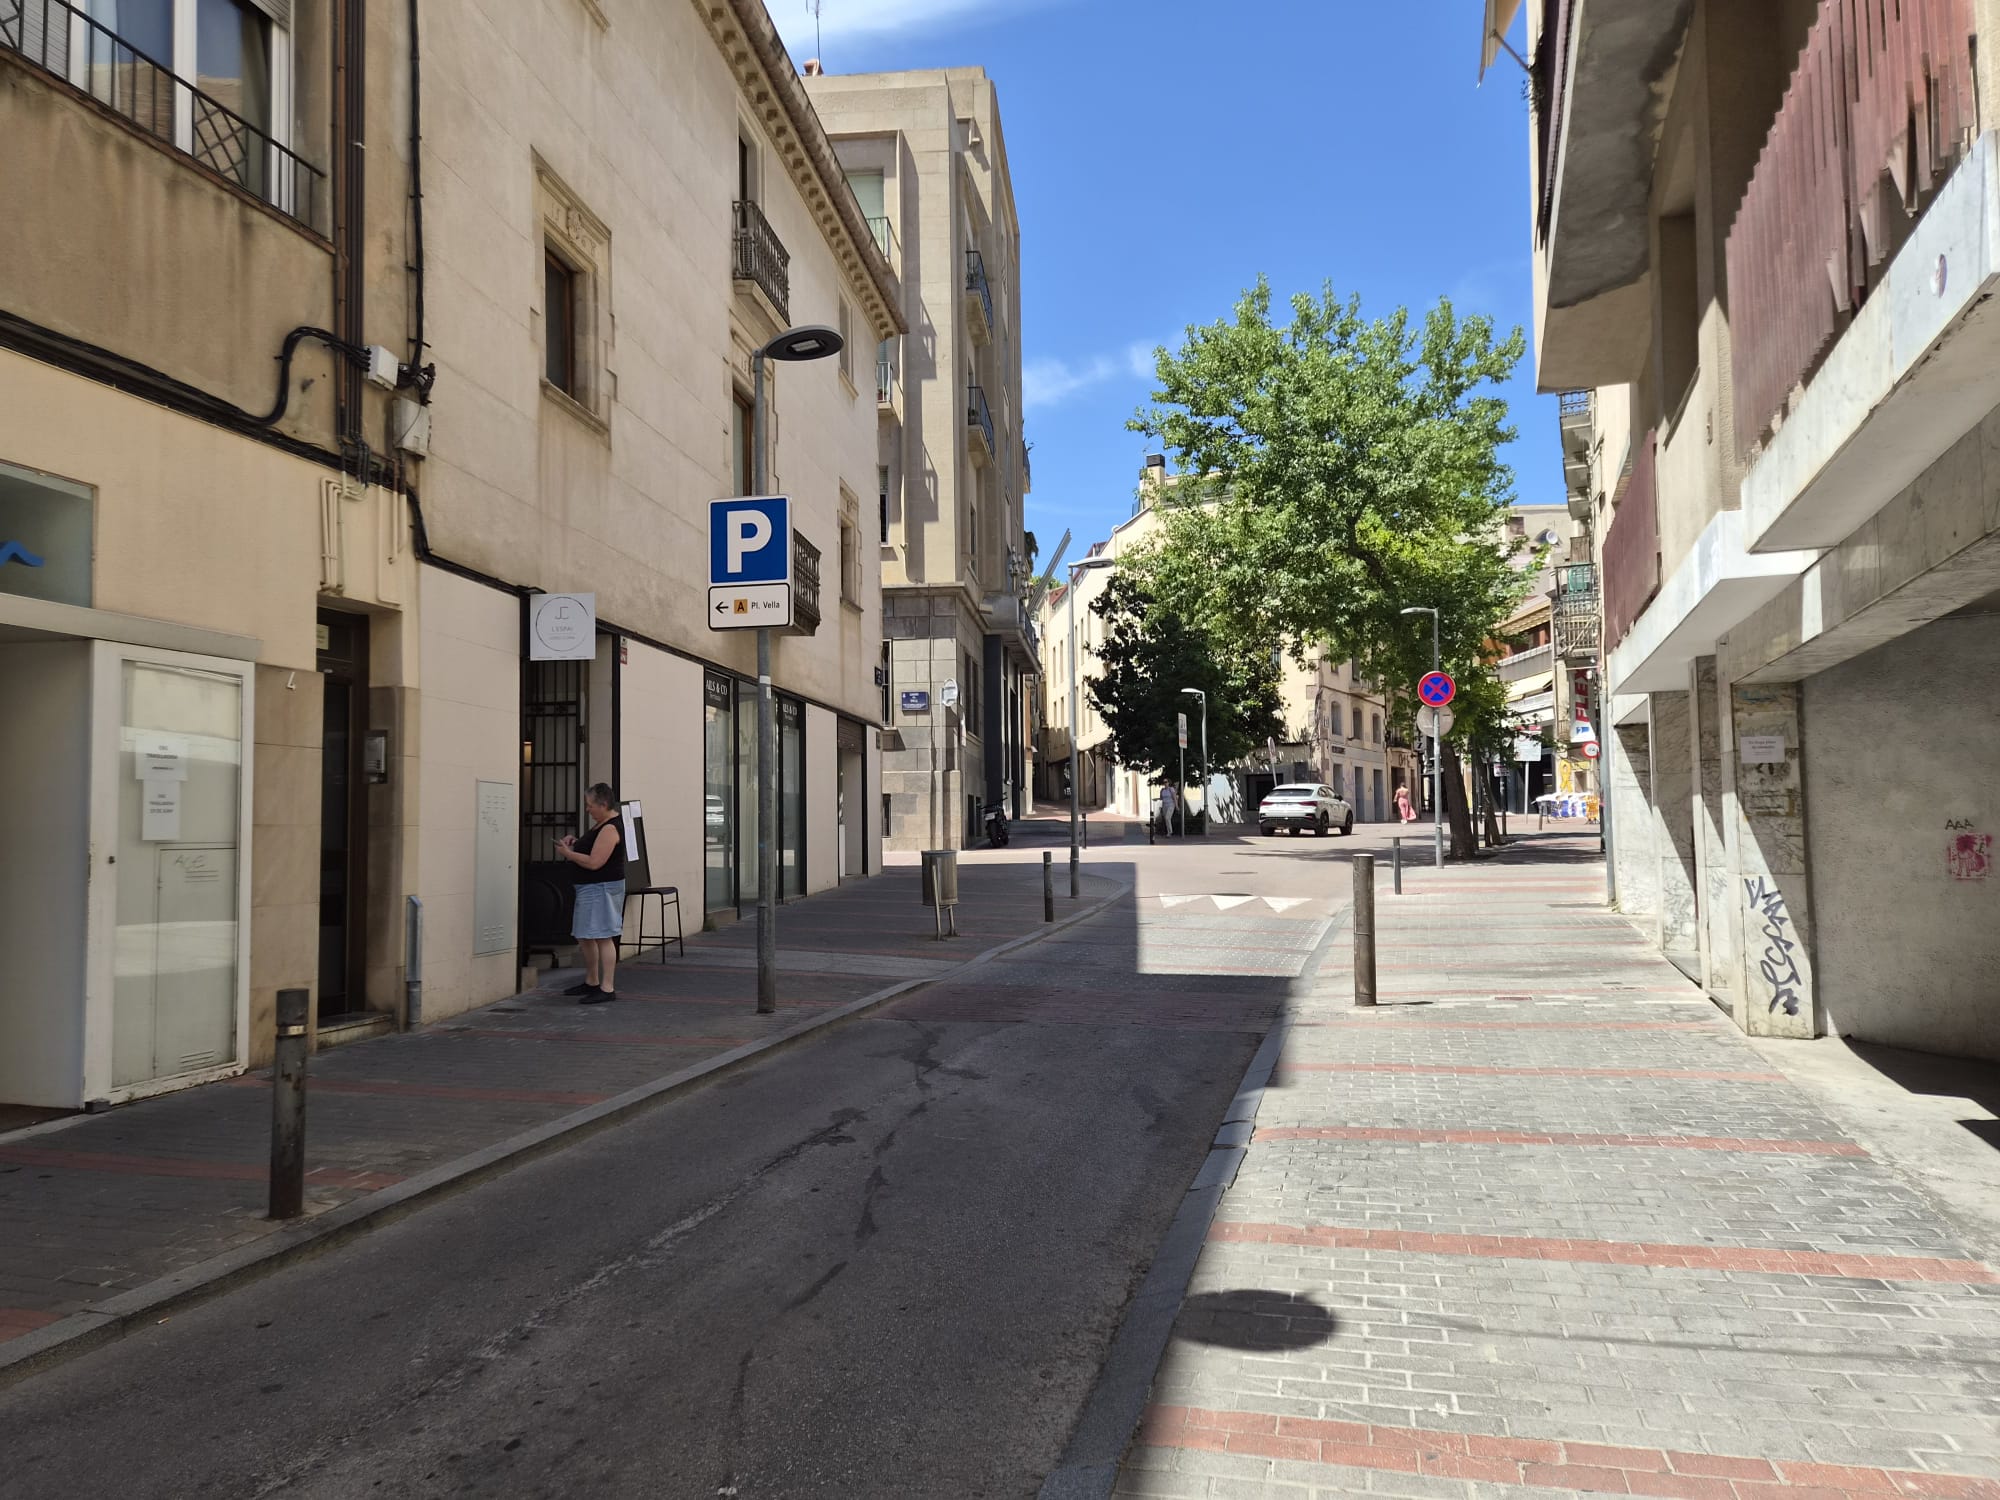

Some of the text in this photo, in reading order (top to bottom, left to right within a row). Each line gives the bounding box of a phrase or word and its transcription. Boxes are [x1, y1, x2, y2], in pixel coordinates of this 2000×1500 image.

[727, 509, 772, 574] P
[737, 600, 780, 612] A Pl. Vella
[1575, 668, 1590, 723] FLEX
